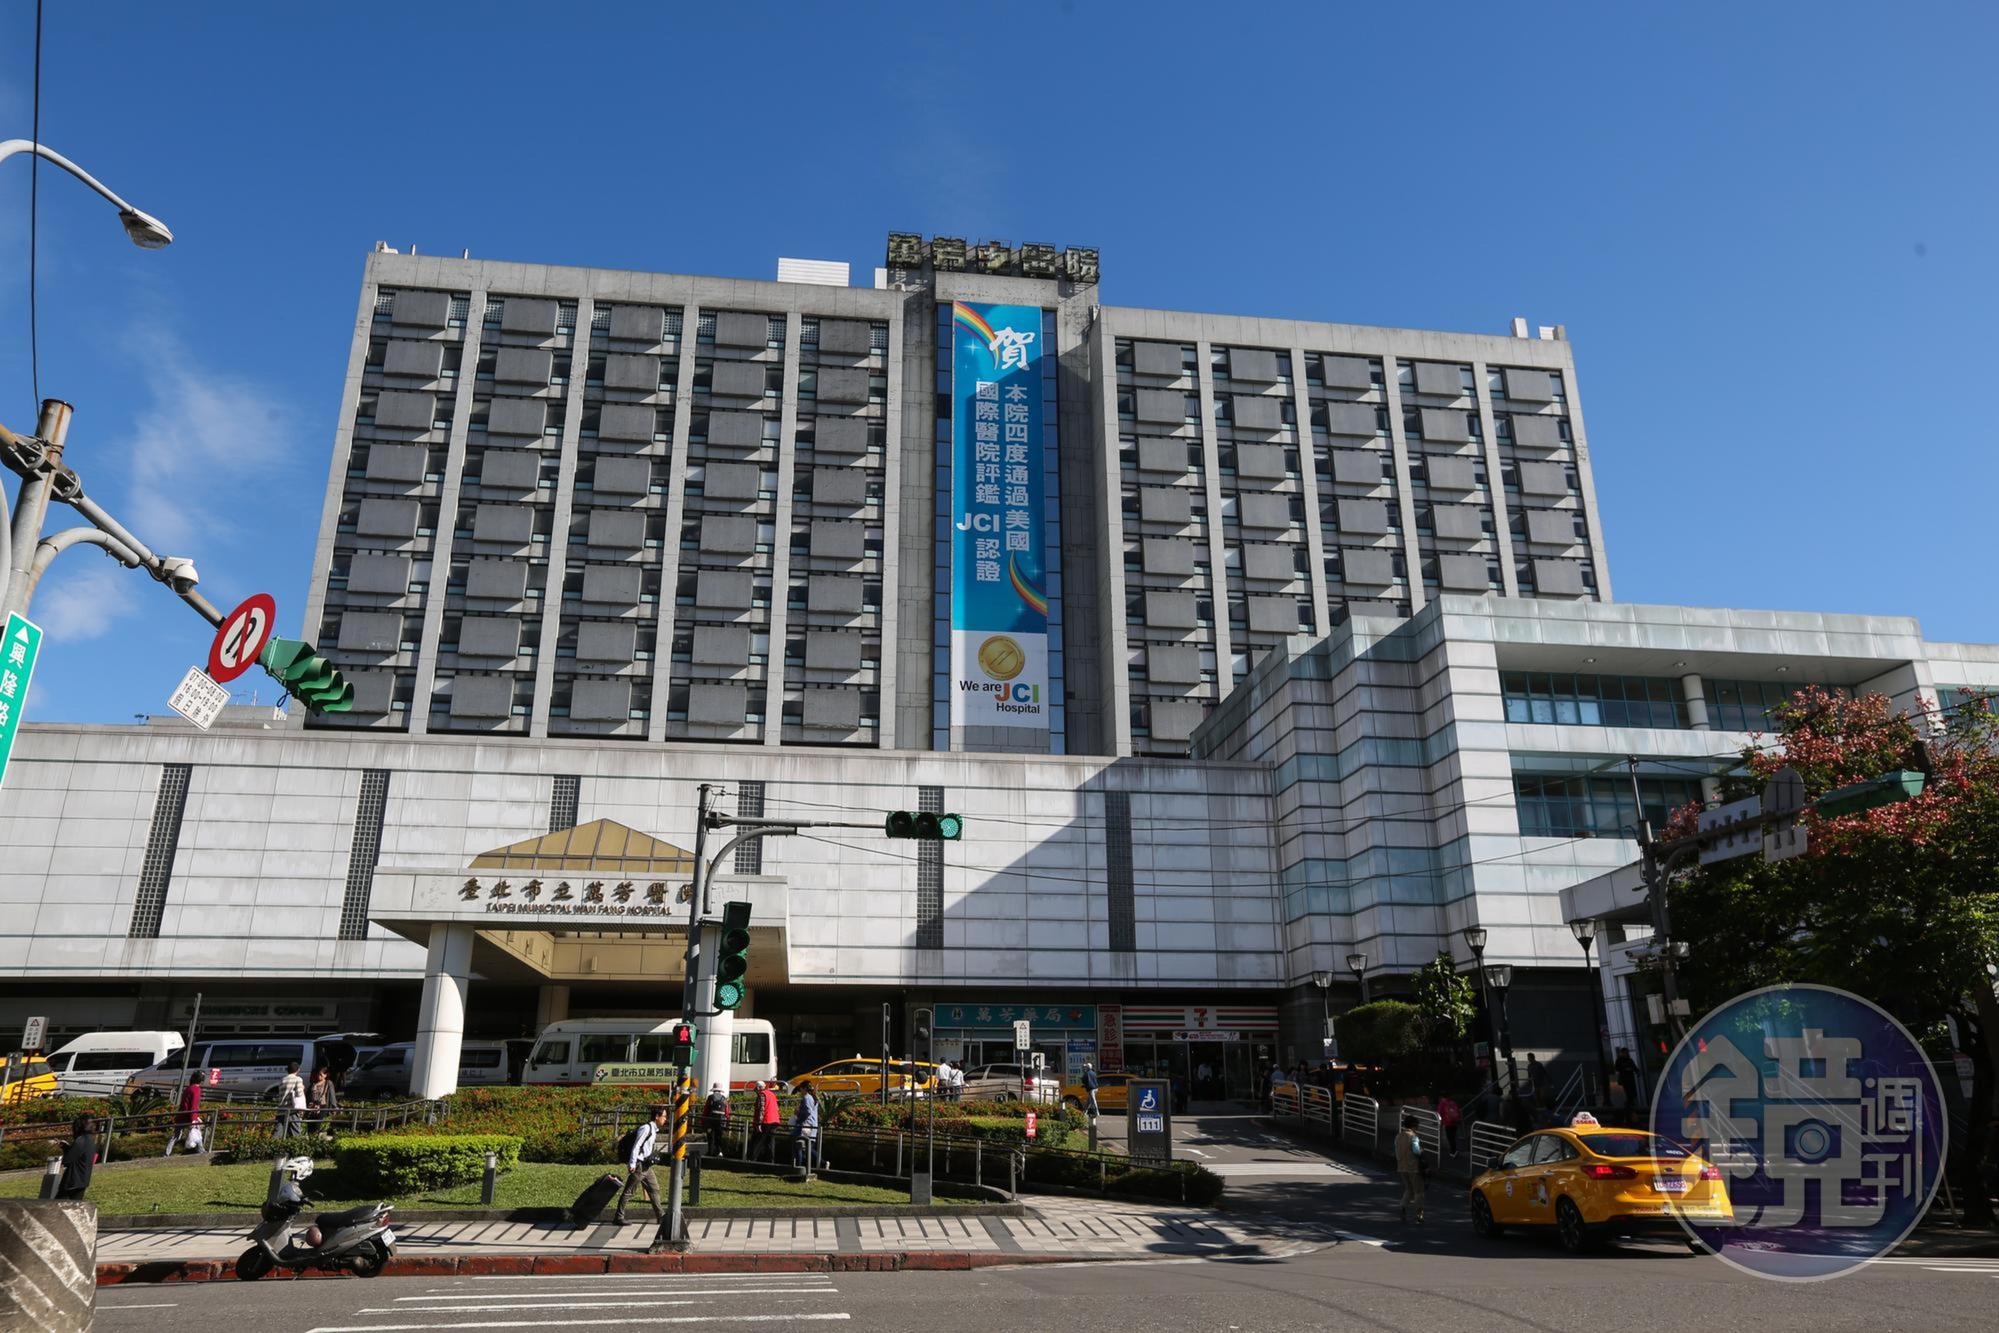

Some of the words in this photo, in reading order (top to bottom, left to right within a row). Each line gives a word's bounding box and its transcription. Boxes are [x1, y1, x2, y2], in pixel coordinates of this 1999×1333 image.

[989, 326, 1036, 371] 賀
[975, 381, 1000, 505] 國際醫院評鑑
[1004, 384, 1030, 551] 本院四度通過美國
[956, 513, 1000, 532] JCI
[975, 538, 1001, 582] 認證
[0, 642, 26, 739] 興隆路
[959, 681, 979, 691] We
[983, 683, 1002, 692] are
[994, 682, 1040, 703] JCI
[996, 702, 1040, 714] Hospital
[485, 902, 516, 913] TAIPEI
[517, 903, 571, 915] MUNICIPAL
[573, 904, 596, 915] WAN
[597, 905, 625, 915] FANG
[627, 905, 672, 916] HOSPITAL
[976, 1007, 1062, 1022] 萬芳藥局
[1142, 1121, 1159, 1130] 111
